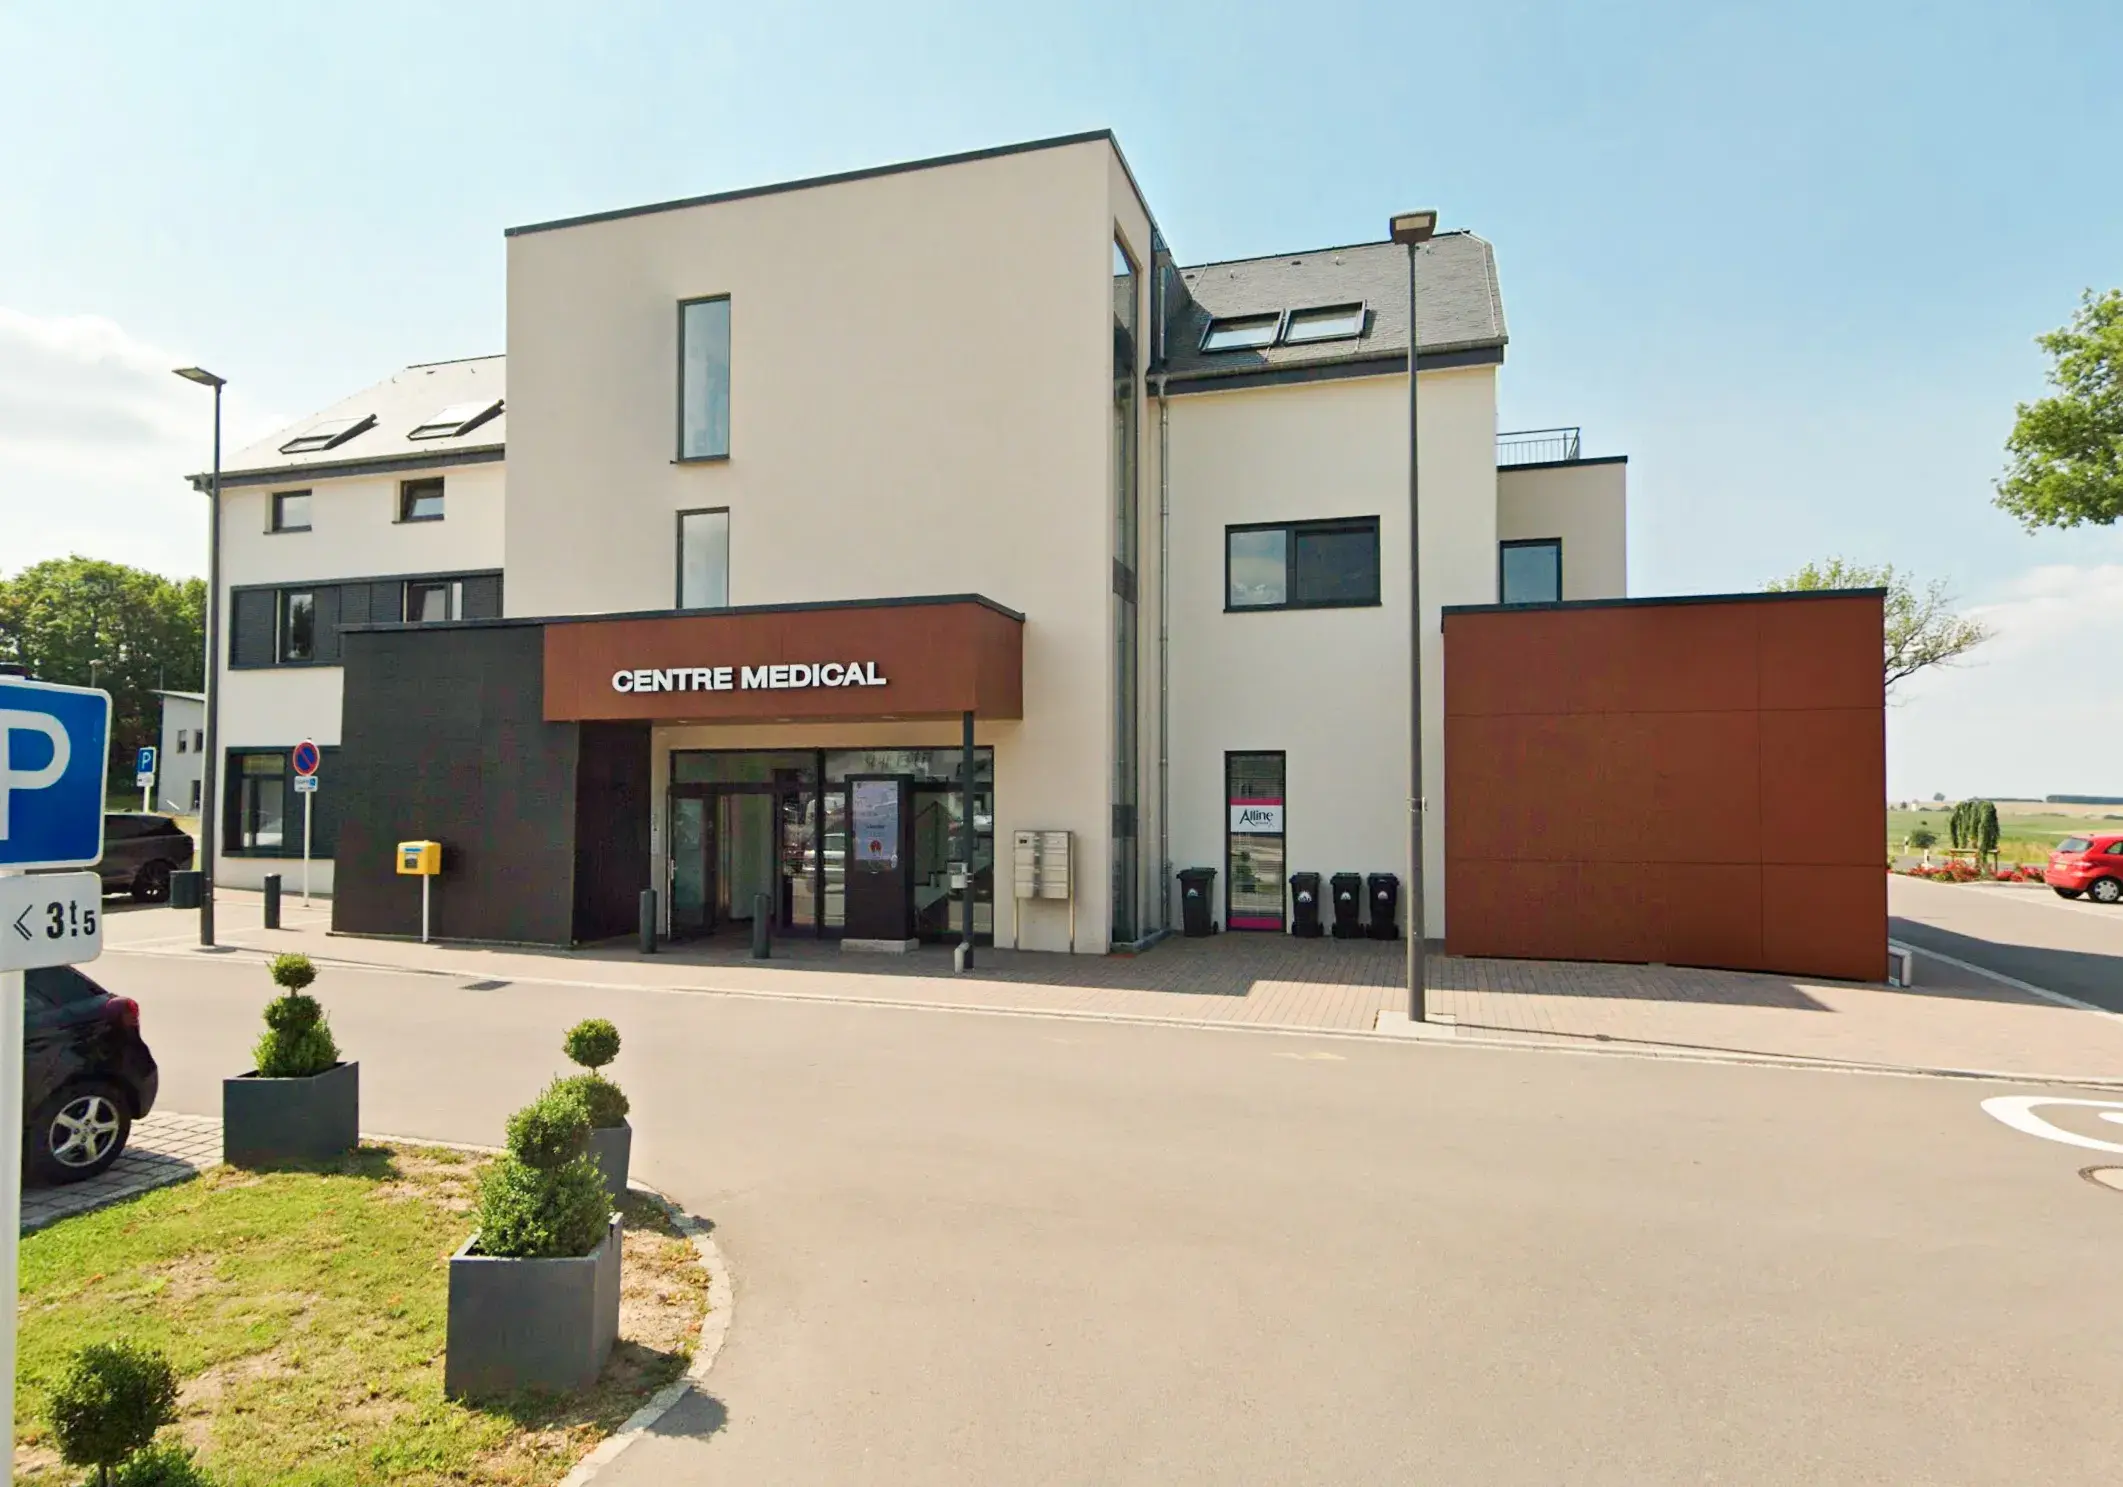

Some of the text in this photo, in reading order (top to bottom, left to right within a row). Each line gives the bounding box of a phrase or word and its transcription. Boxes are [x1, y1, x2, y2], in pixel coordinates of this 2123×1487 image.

[611, 661, 887, 692] CENTRE MEDICAL
[141, 751, 151, 769] P
[0, 710, 71, 840] P
[1239, 808, 1274, 826] Alline
